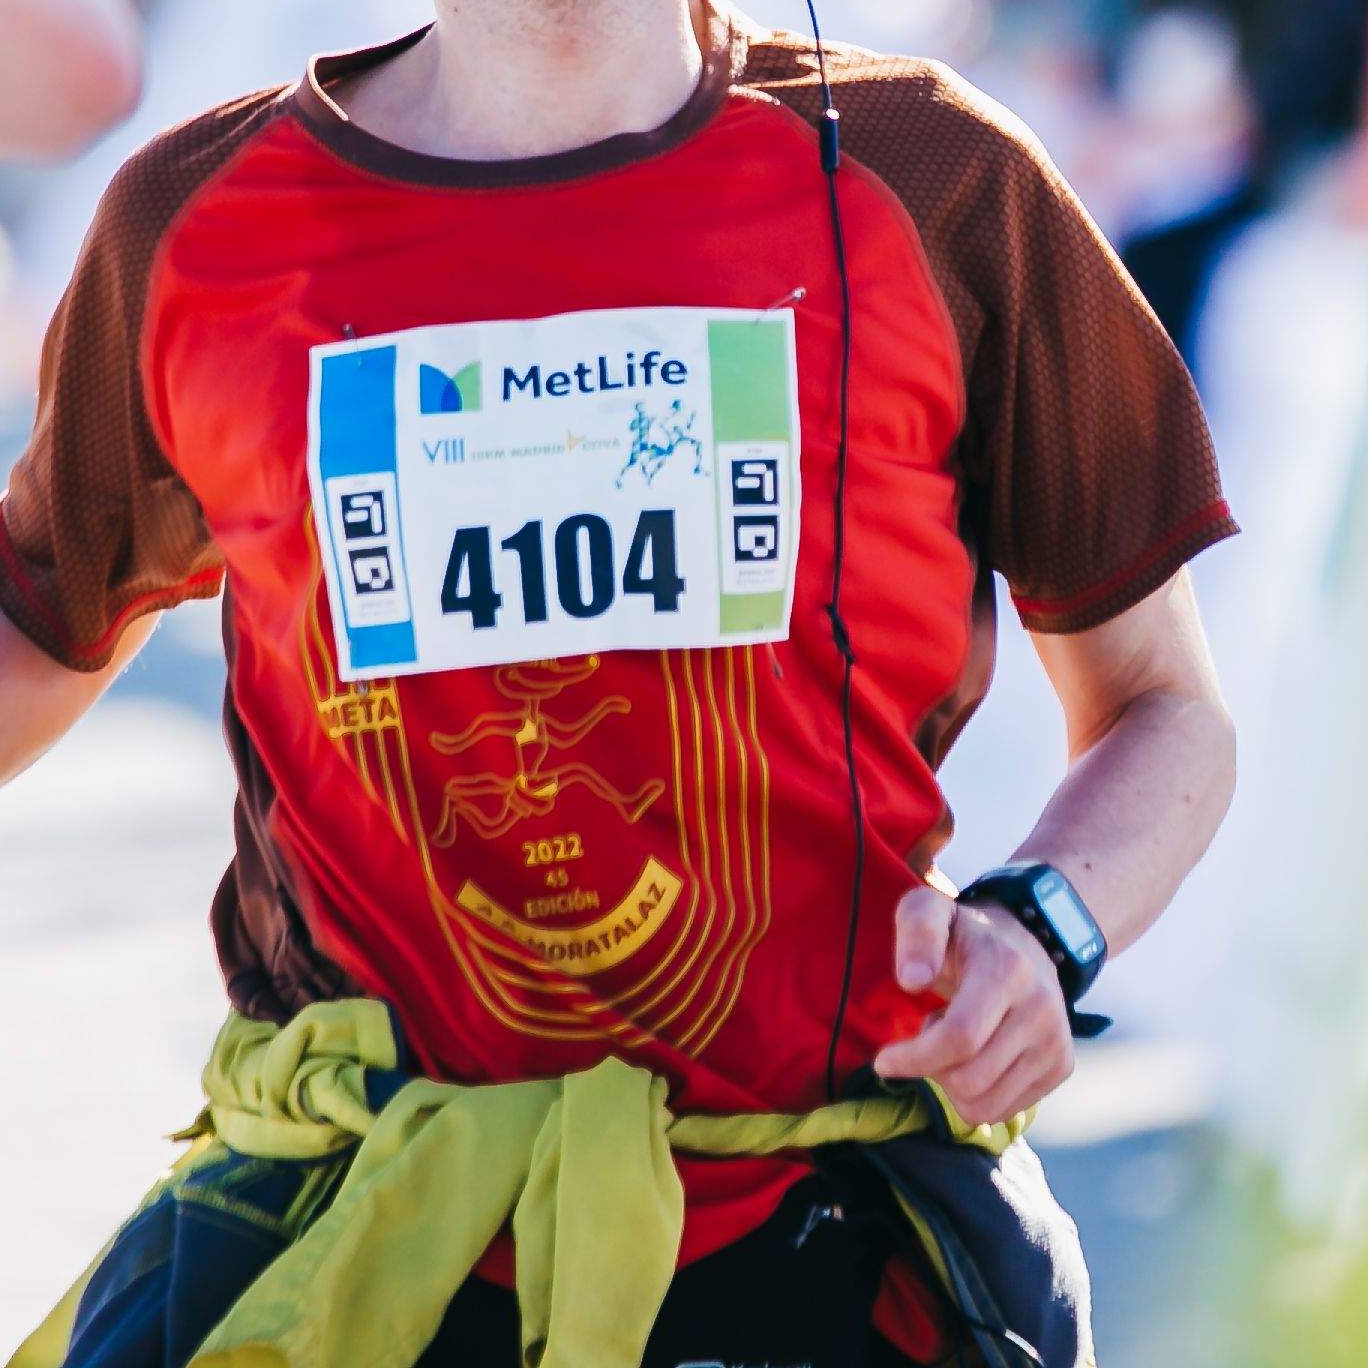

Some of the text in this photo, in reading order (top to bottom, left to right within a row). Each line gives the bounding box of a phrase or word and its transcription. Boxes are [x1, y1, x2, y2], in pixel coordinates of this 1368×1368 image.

[501, 351, 689, 403] MetLife
[421, 436, 465, 465] VIII
[439, 508, 688, 631] 4104
[523, 833, 584, 866] 2022
[525, 886, 601, 919] EDICIÓN
